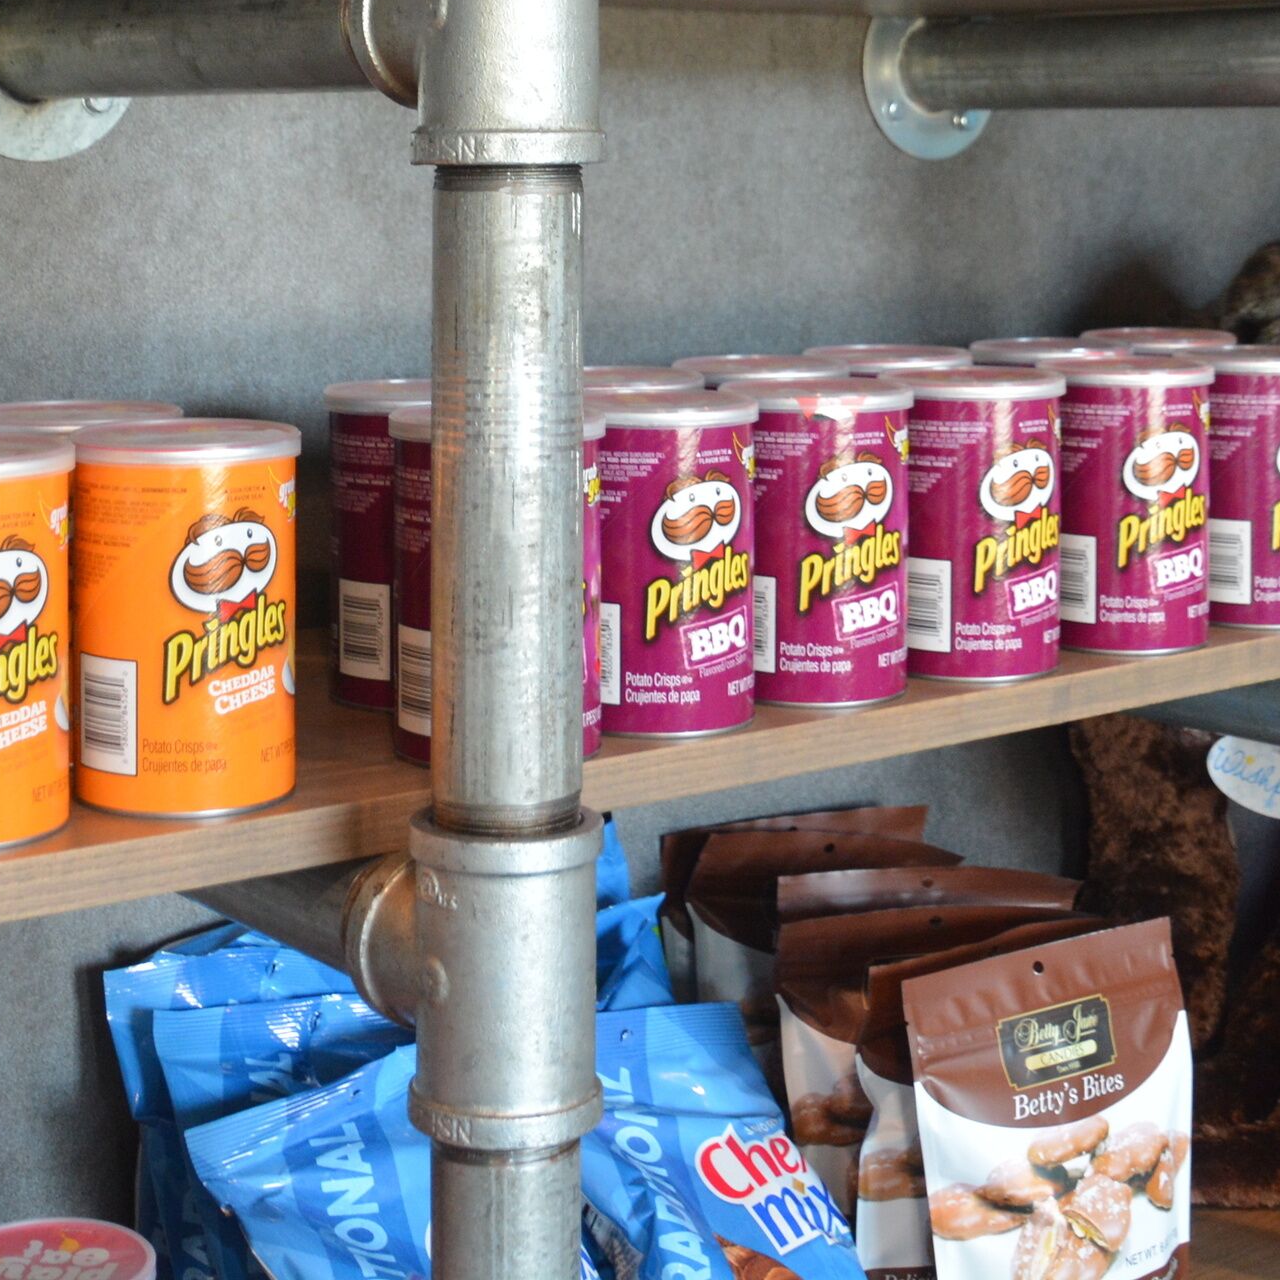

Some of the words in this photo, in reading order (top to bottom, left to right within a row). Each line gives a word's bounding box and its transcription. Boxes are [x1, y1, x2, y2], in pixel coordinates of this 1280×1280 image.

[1117, 488, 1206, 569] Pringles
[798, 523, 900, 613] Pringles
[973, 507, 1059, 594] Pringles
[1156, 546, 1204, 588] BBQ
[645, 546, 749, 641] Pringles
[1011, 569, 1058, 612] BBQ
[840, 591, 898, 634] BBQ
[162, 591, 287, 706] Pringles
[689, 614, 747, 662] BBQ
[780, 641, 806, 657] Potato
[208, 663, 275, 699] CHEDDAR
[625, 671, 653, 687] Potato
[653, 671, 681, 689] Crisps
[820, 659, 831, 673] de
[214, 678, 276, 716] CHEESE
[668, 688, 680, 704] de
[680, 689, 701, 705] papa
[142, 740, 173, 755] Potato
[174, 738, 205, 758] Crisps
[191, 756, 205, 772] de
[206, 756, 228, 775] papa
[1012, 1081, 1079, 1121] Betty's
[1081, 1072, 1125, 1101] Bites
